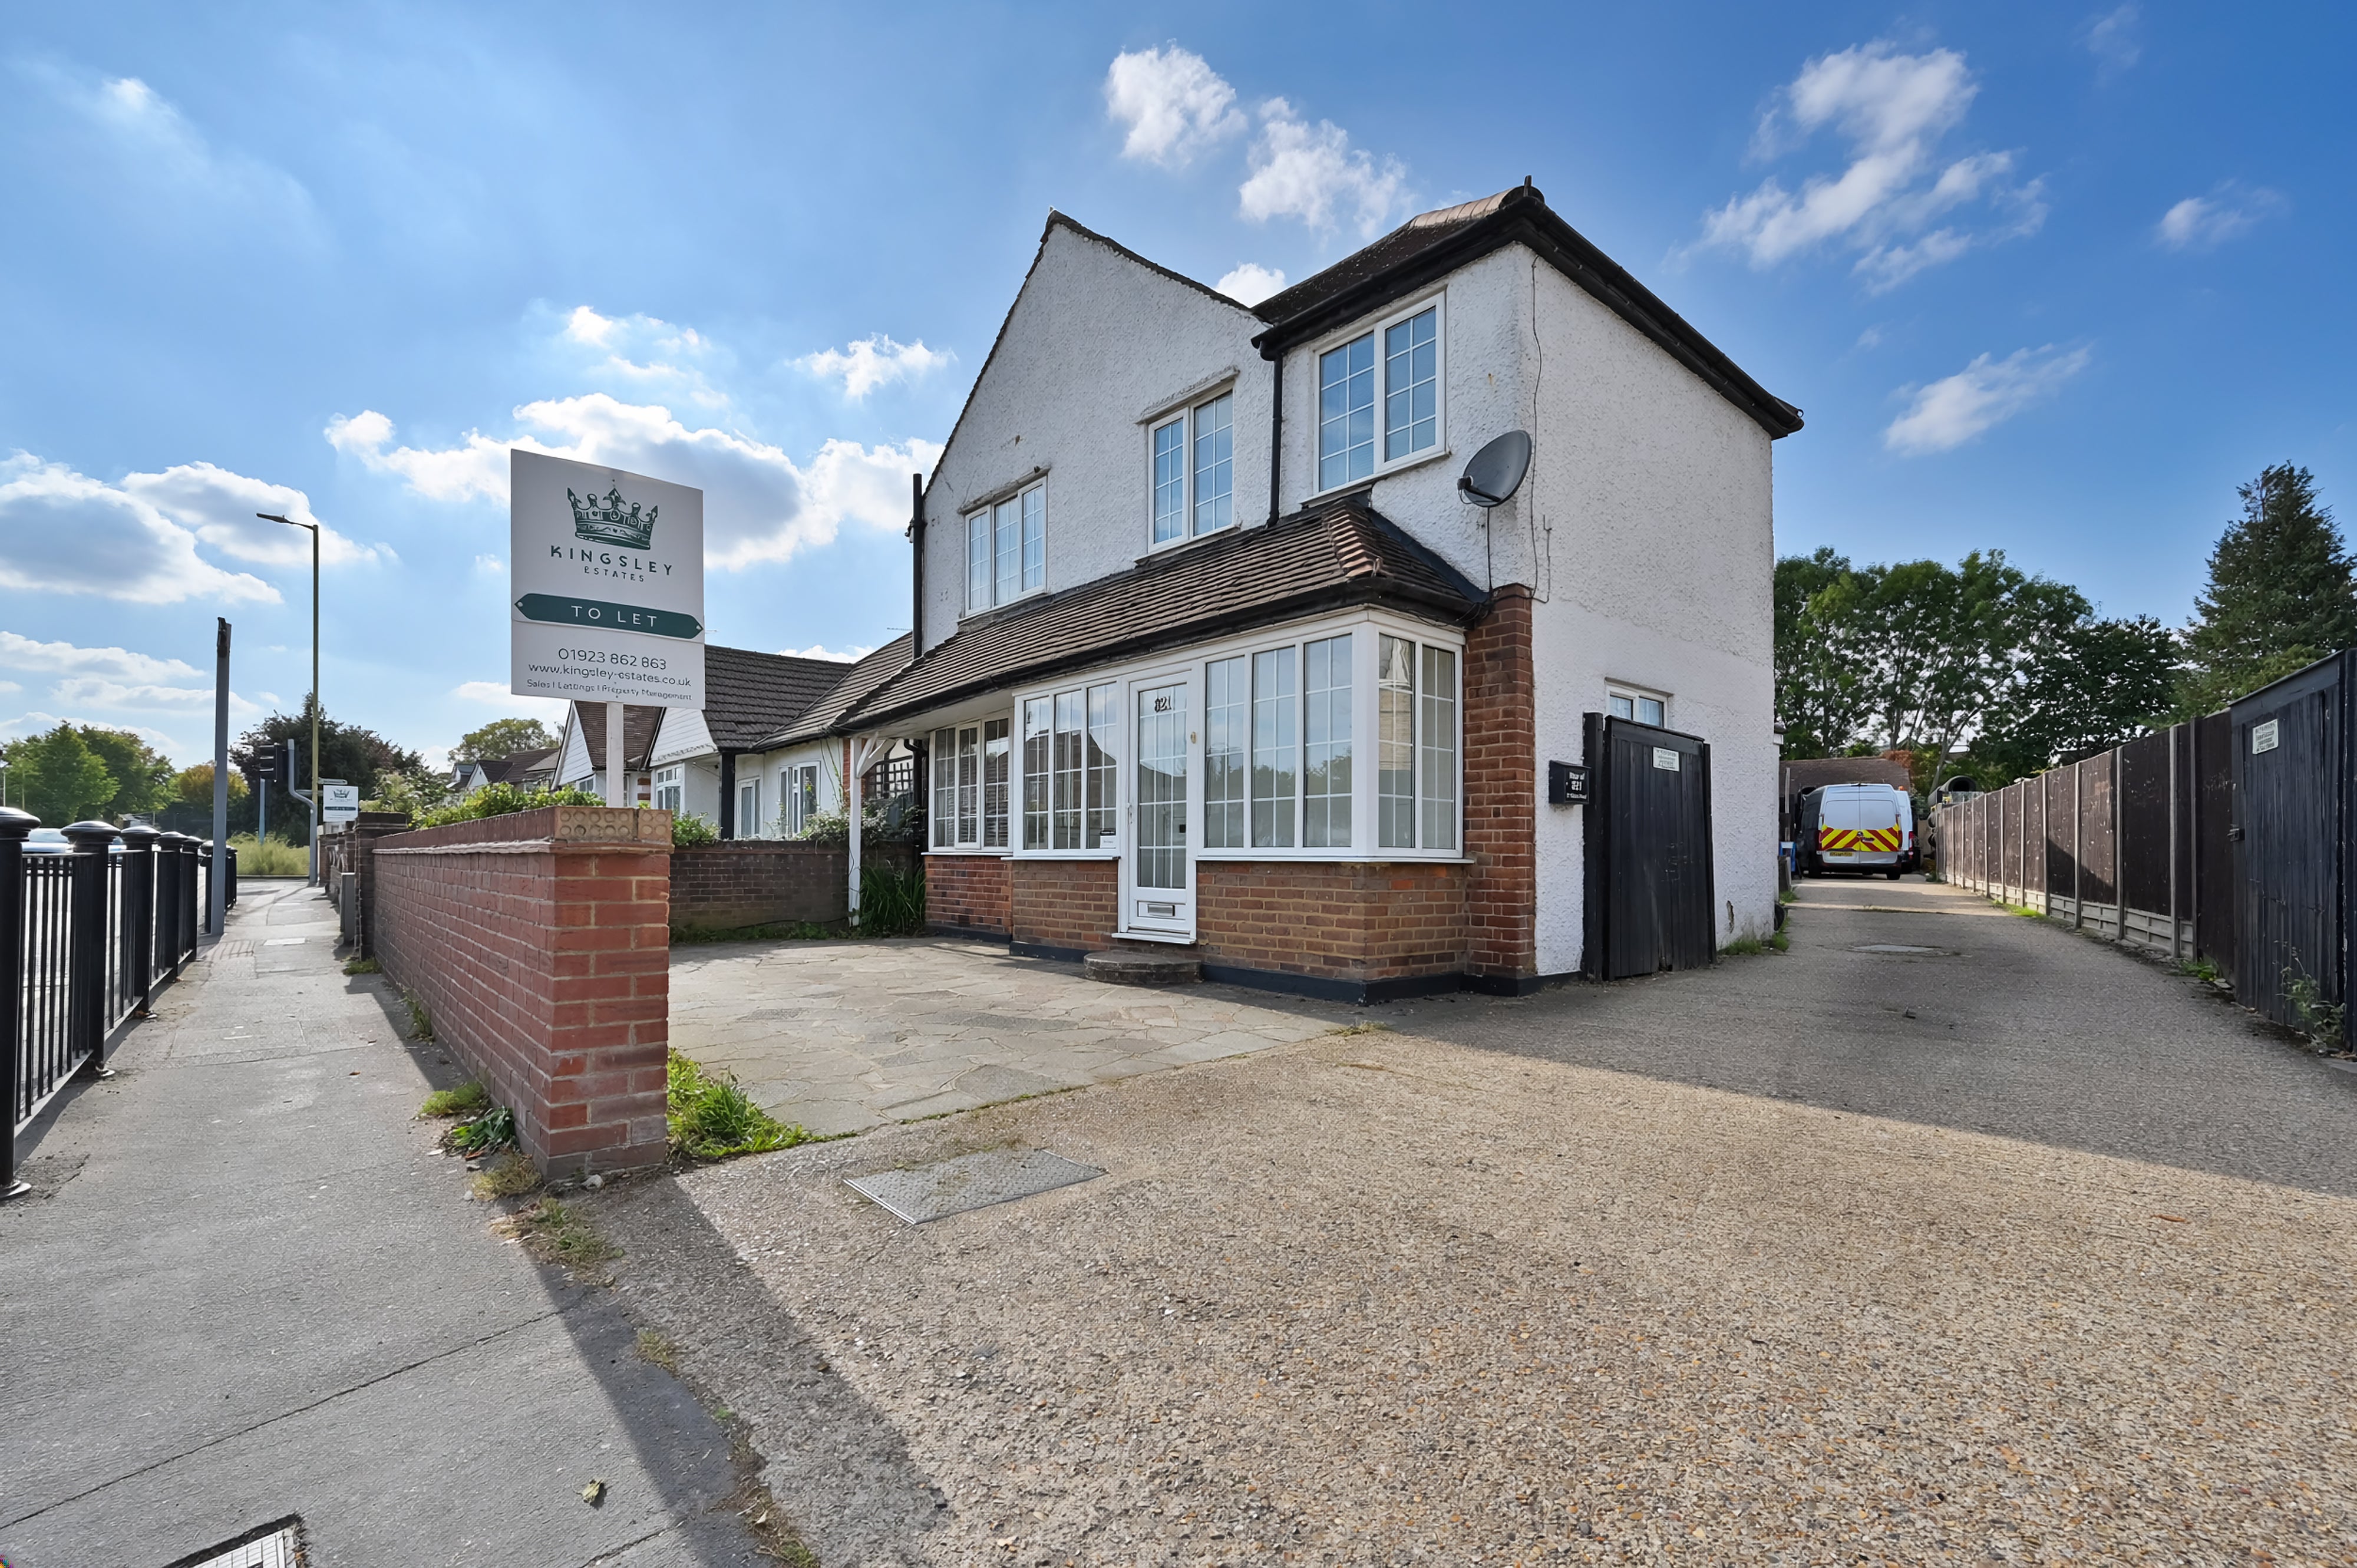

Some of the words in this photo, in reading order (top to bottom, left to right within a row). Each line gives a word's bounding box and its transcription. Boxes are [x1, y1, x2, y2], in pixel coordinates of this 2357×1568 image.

[551, 545, 672, 576] KINGSLEY
[585, 566, 644, 582] ESTATES
[571, 605, 601, 619] TO
[618, 610, 657, 628] LET
[558, 648, 606, 663] 01923
[610, 653, 638, 666] 862
[641, 656, 666, 670] 863
[528, 663, 692, 687] www.kingsley-estates.co.uk
[527, 679, 550, 688] Sales
[558, 682, 595, 692] Lettings
[602, 685, 639, 696] Property
[642, 689, 692, 700] Management
